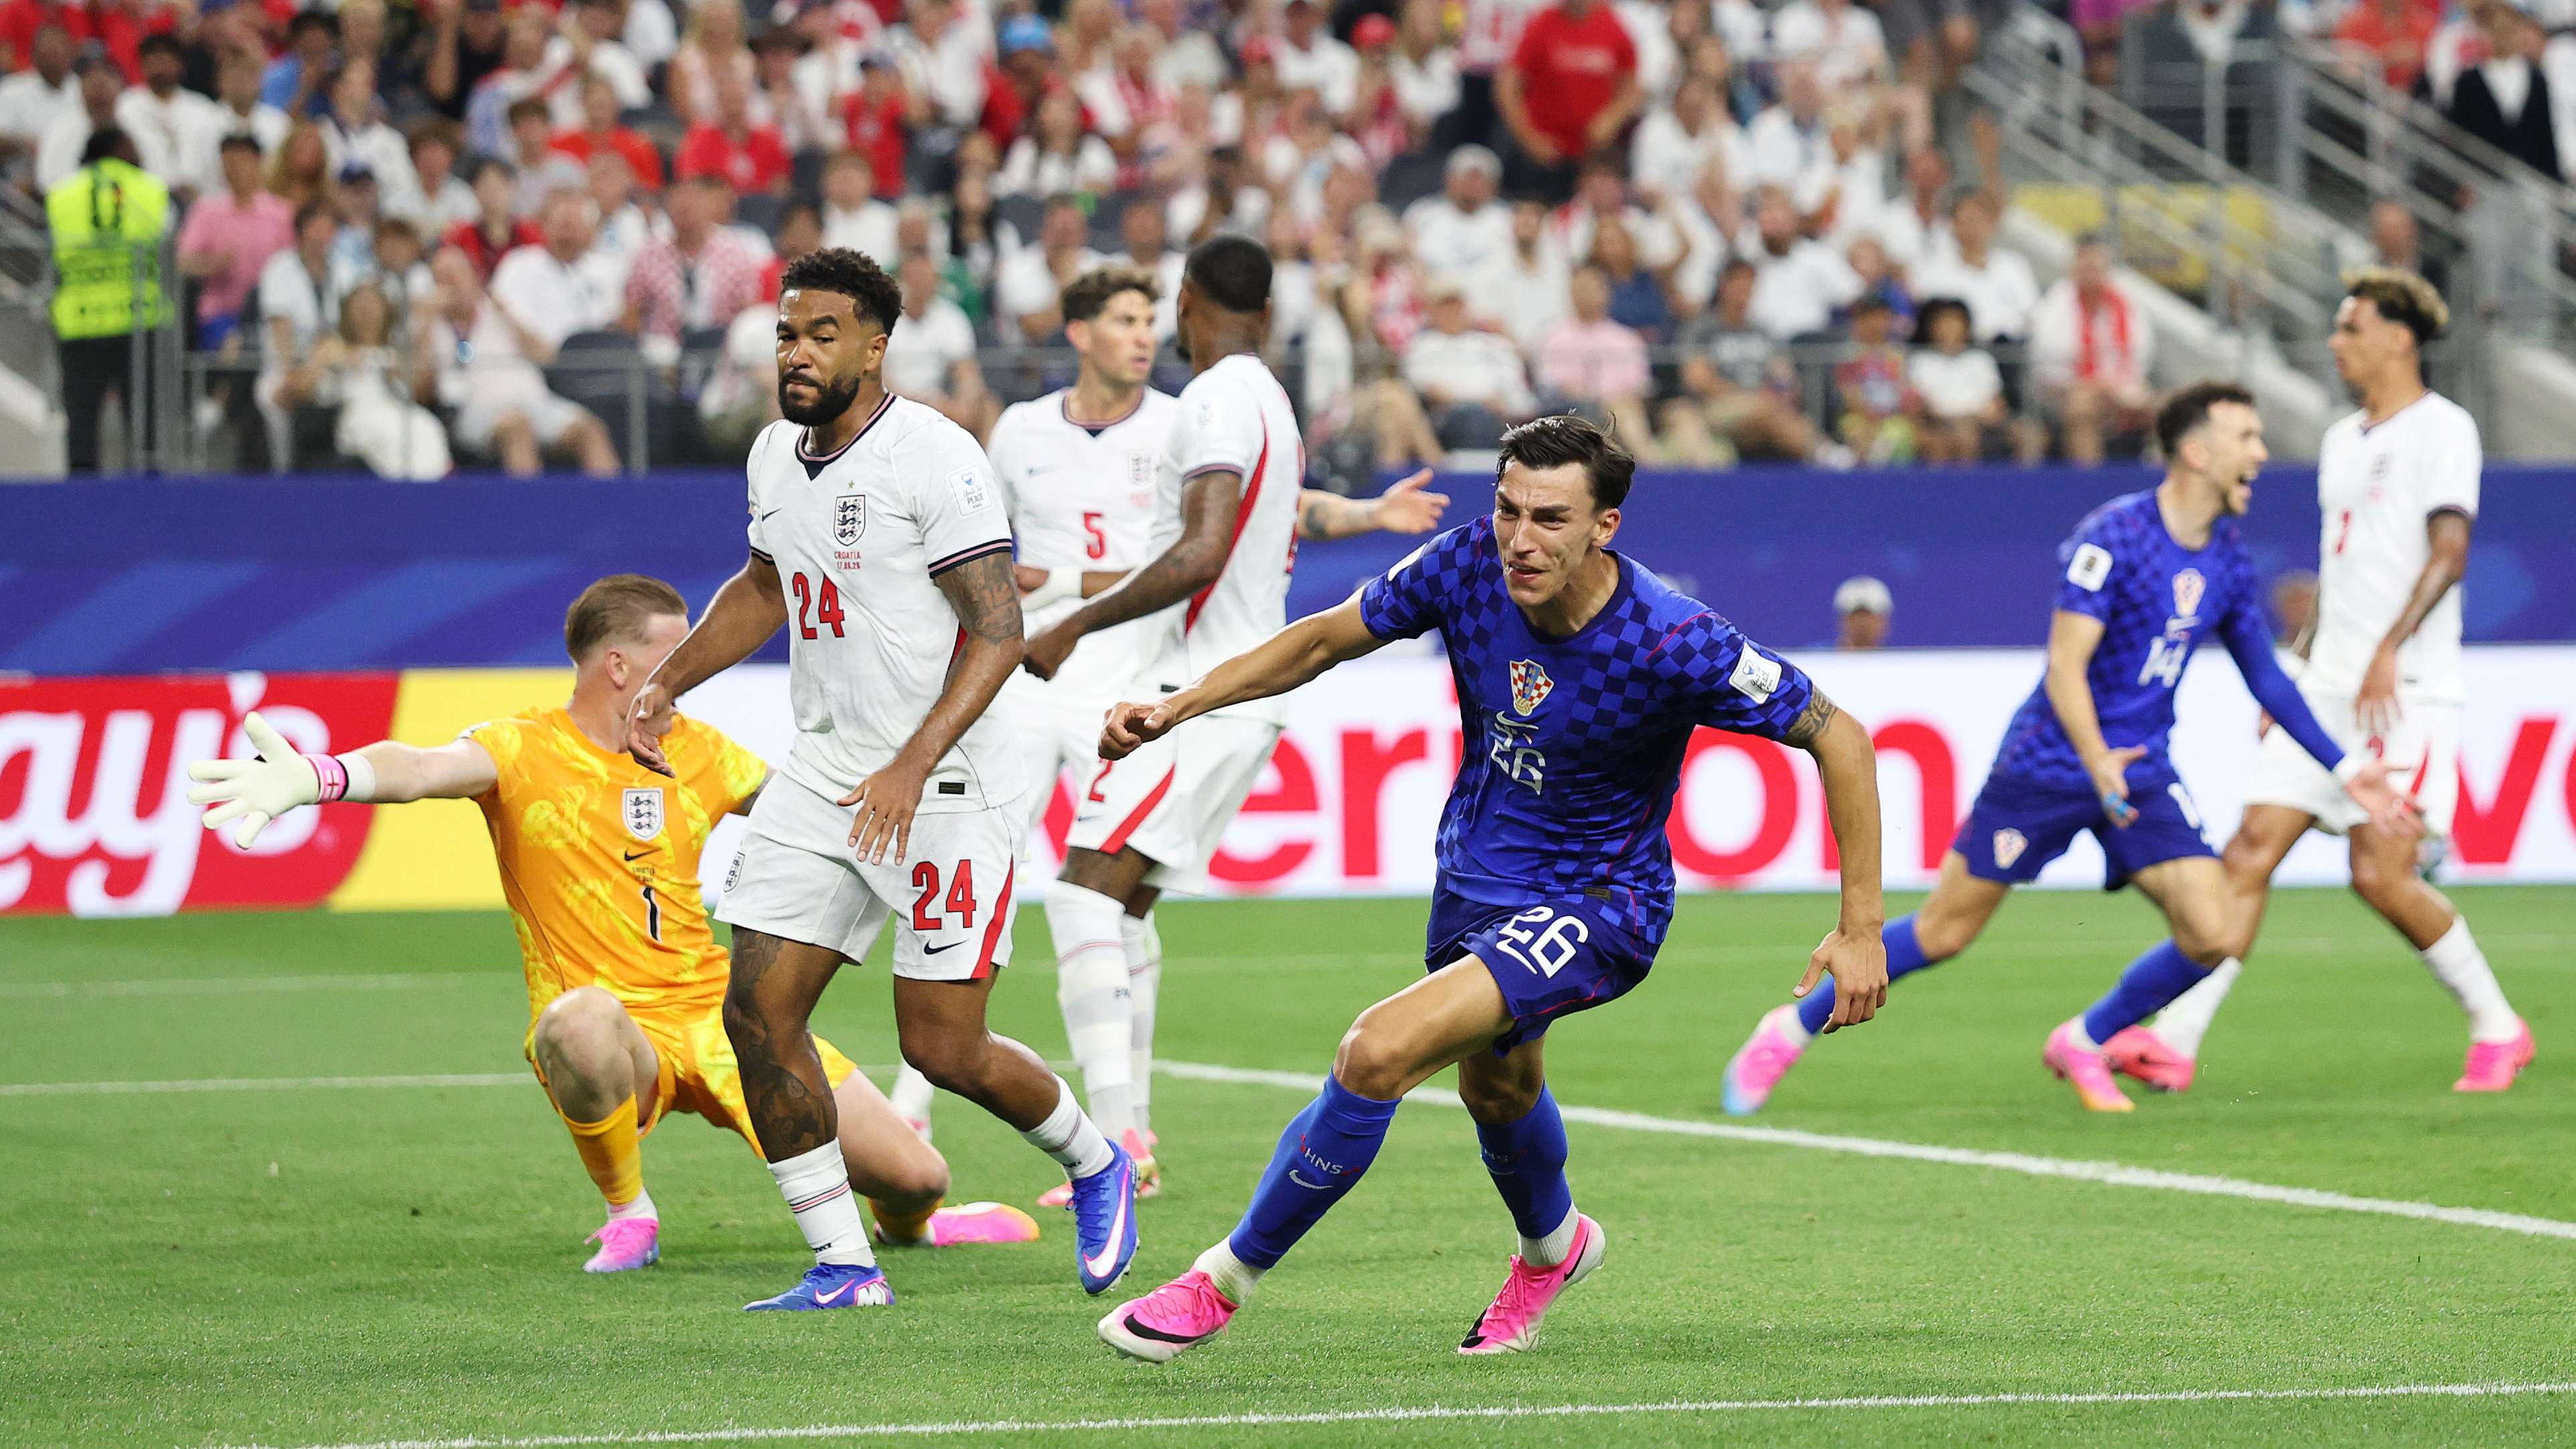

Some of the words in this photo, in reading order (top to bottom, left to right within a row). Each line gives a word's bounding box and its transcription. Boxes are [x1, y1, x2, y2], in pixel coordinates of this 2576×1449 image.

[834, 551, 861, 559] CROATIA
[1082, 512, 1105, 560] 5
[792, 572, 846, 640] 24
[2137, 636, 2189, 686] 14
[0, 670, 331, 919] ay's
[1088, 758, 1113, 803] 2
[642, 886, 661, 942] 1
[912, 859, 977, 931] 24
[1496, 906, 1589, 979] 26
[1304, 1147, 1343, 1175] HNS
